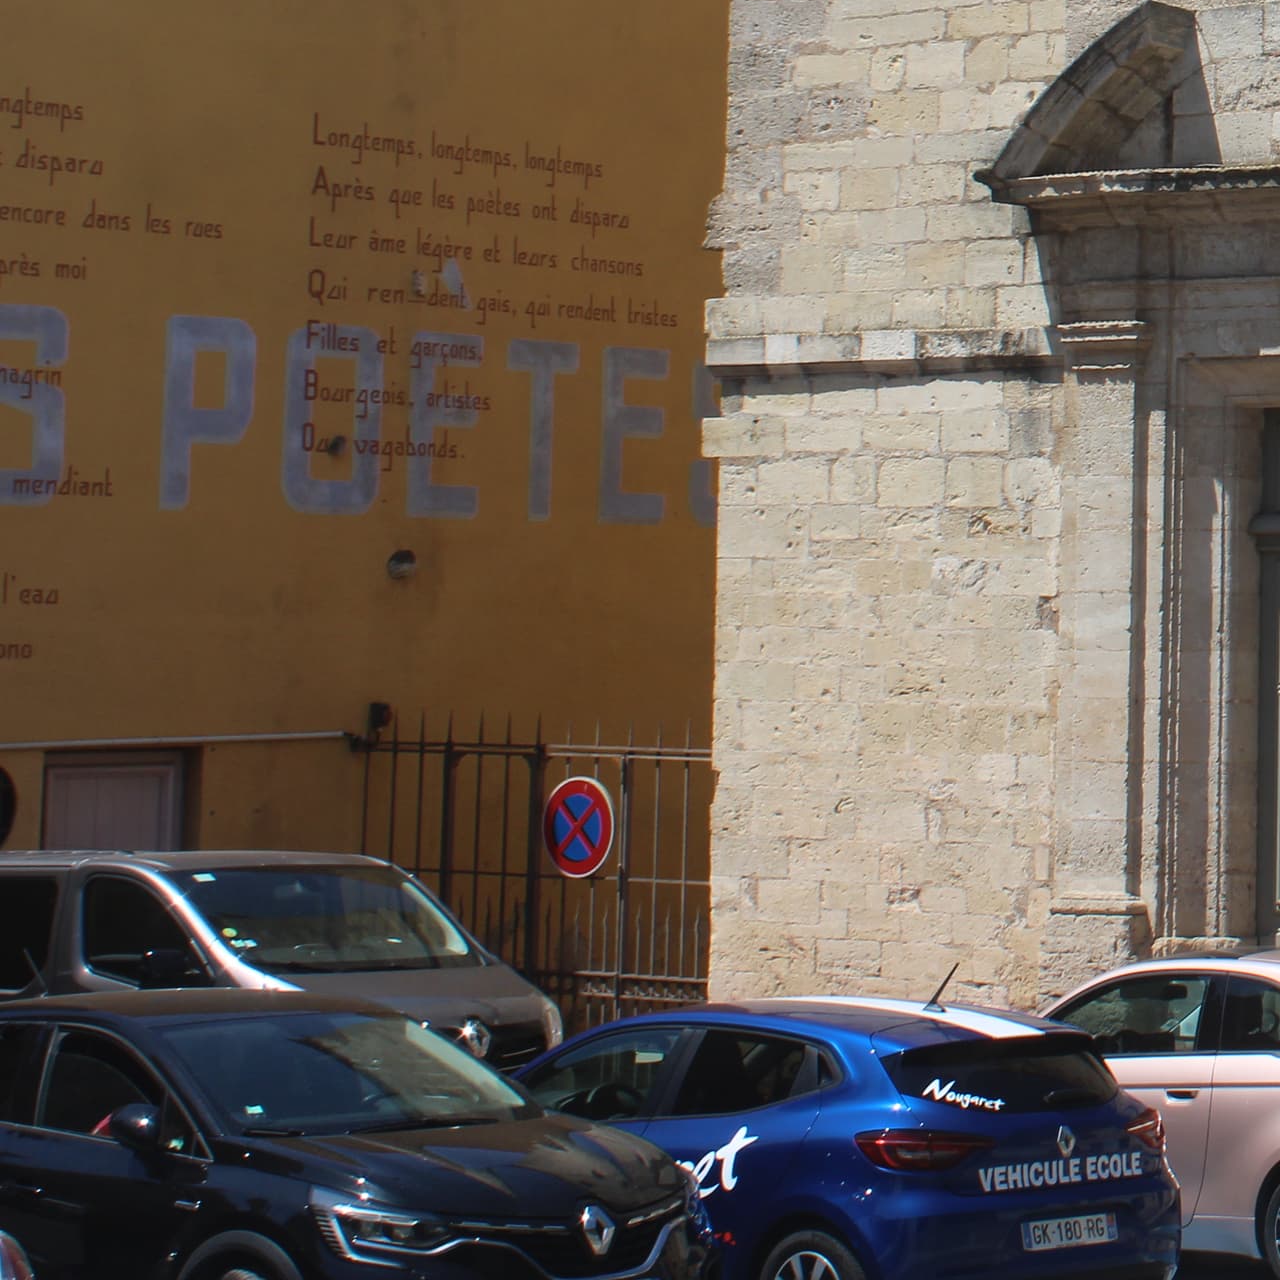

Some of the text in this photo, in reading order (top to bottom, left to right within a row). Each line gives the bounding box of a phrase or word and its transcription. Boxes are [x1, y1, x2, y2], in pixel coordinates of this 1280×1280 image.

[525, 140, 603, 190] longtemps
[311, 165, 375, 213] Après
[389, 188, 423, 219] que
[432, 177, 455, 210] les
[532, 194, 558, 221] ont
[82, 198, 131, 231] dans
[146, 202, 171, 234] les
[185, 220, 223, 239] rues
[309, 216, 643, 277] Leur âme légère et leurs chansons
[55, 256, 87, 280] moi
[308, 269, 347, 306] Qui
[524, 294, 551, 328] qui
[558, 293, 617, 323] rendent
[626, 297, 678, 328] tristes
[306, 320, 360, 352] Filles
[377, 326, 397, 355] et
[427, 379, 491, 410] artistes
[12, 465, 113, 498] mendiant
[922, 1078, 1005, 1111] Nougaret
[979, 1151, 1143, 1192] VEHICULE ECOLE
